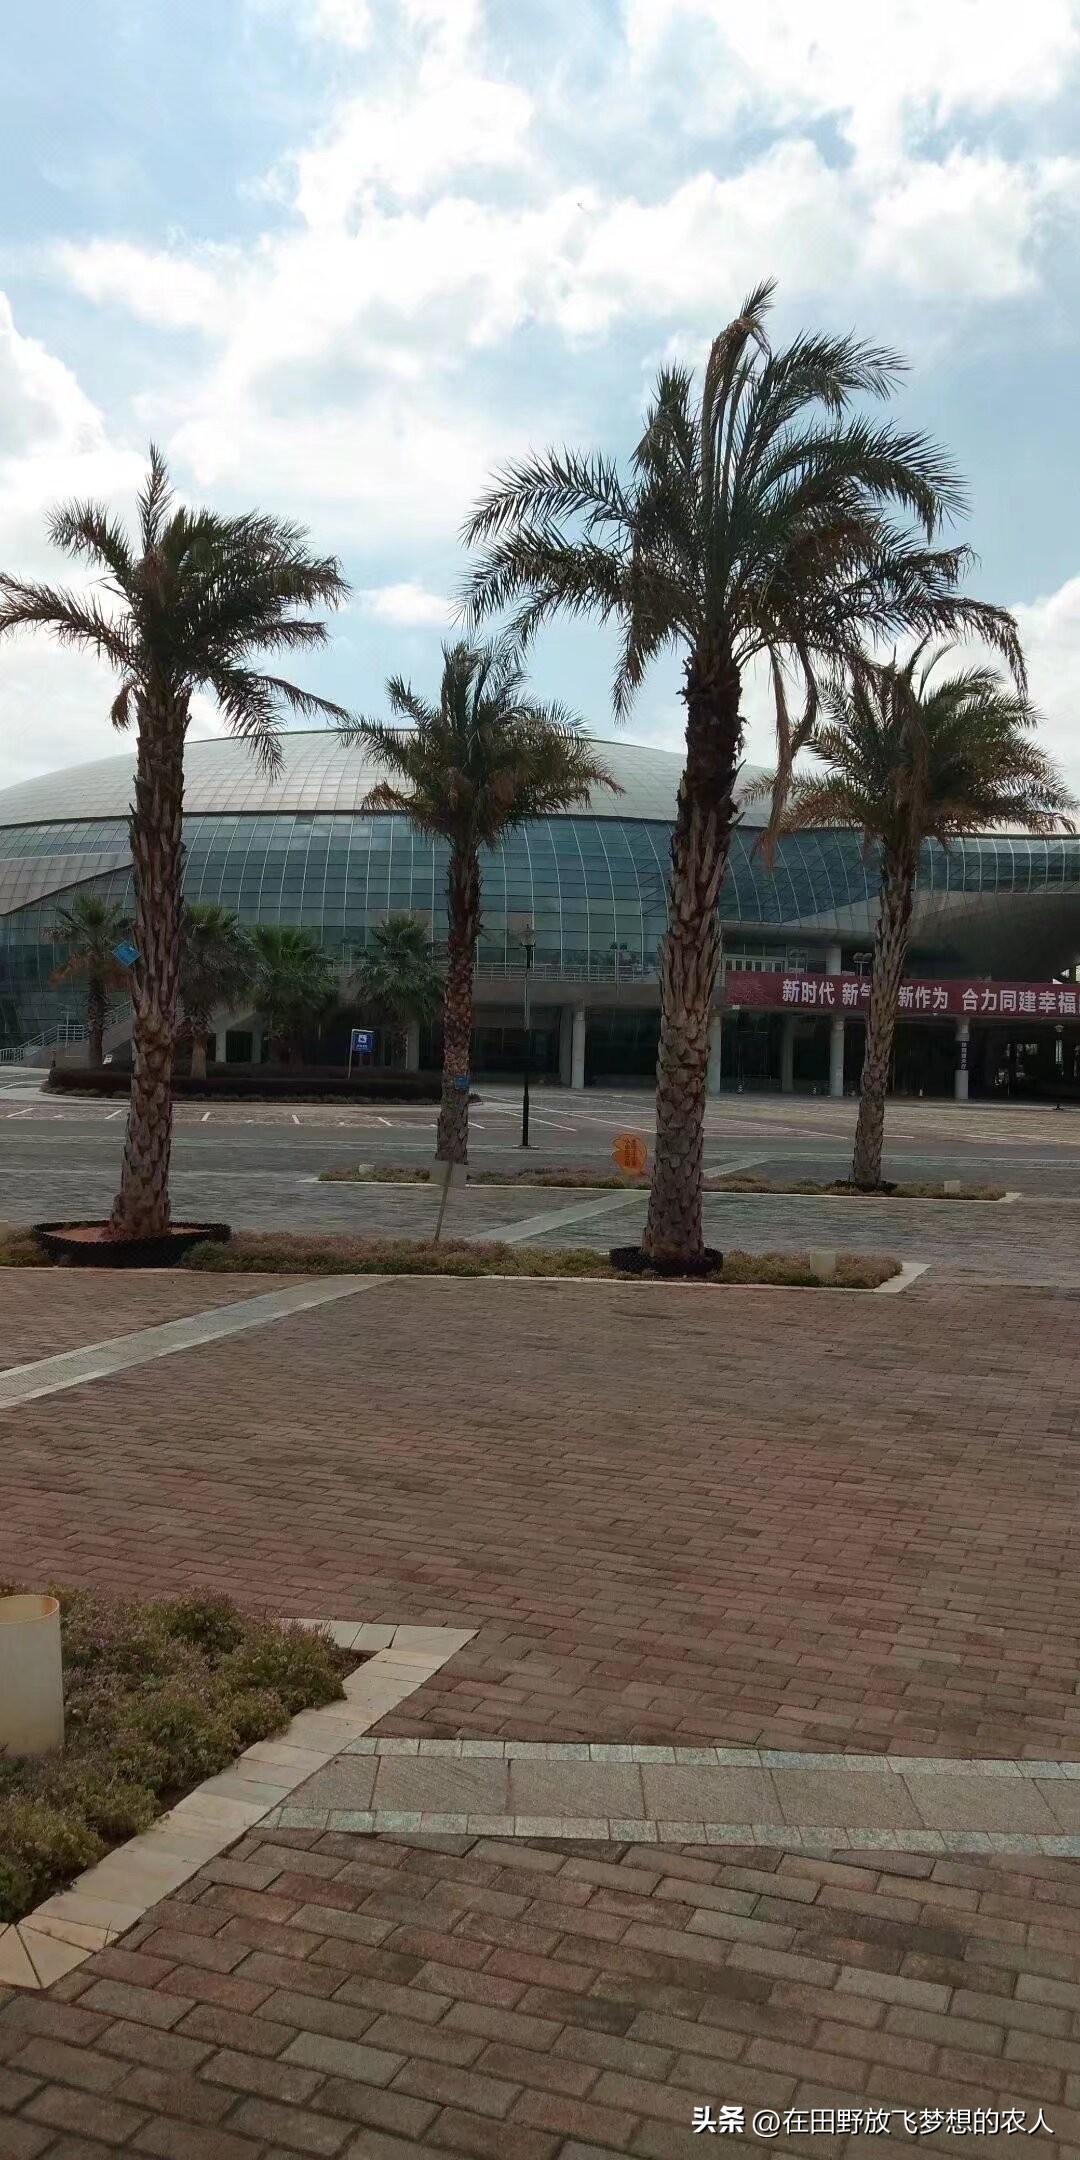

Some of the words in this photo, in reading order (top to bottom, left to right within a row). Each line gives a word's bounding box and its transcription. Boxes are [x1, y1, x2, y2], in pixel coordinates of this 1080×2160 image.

[782, 979, 835, 1005] 新时代
[897, 985, 948, 1010] 新作为
[962, 988, 1080, 1015] 合力同建幸福
